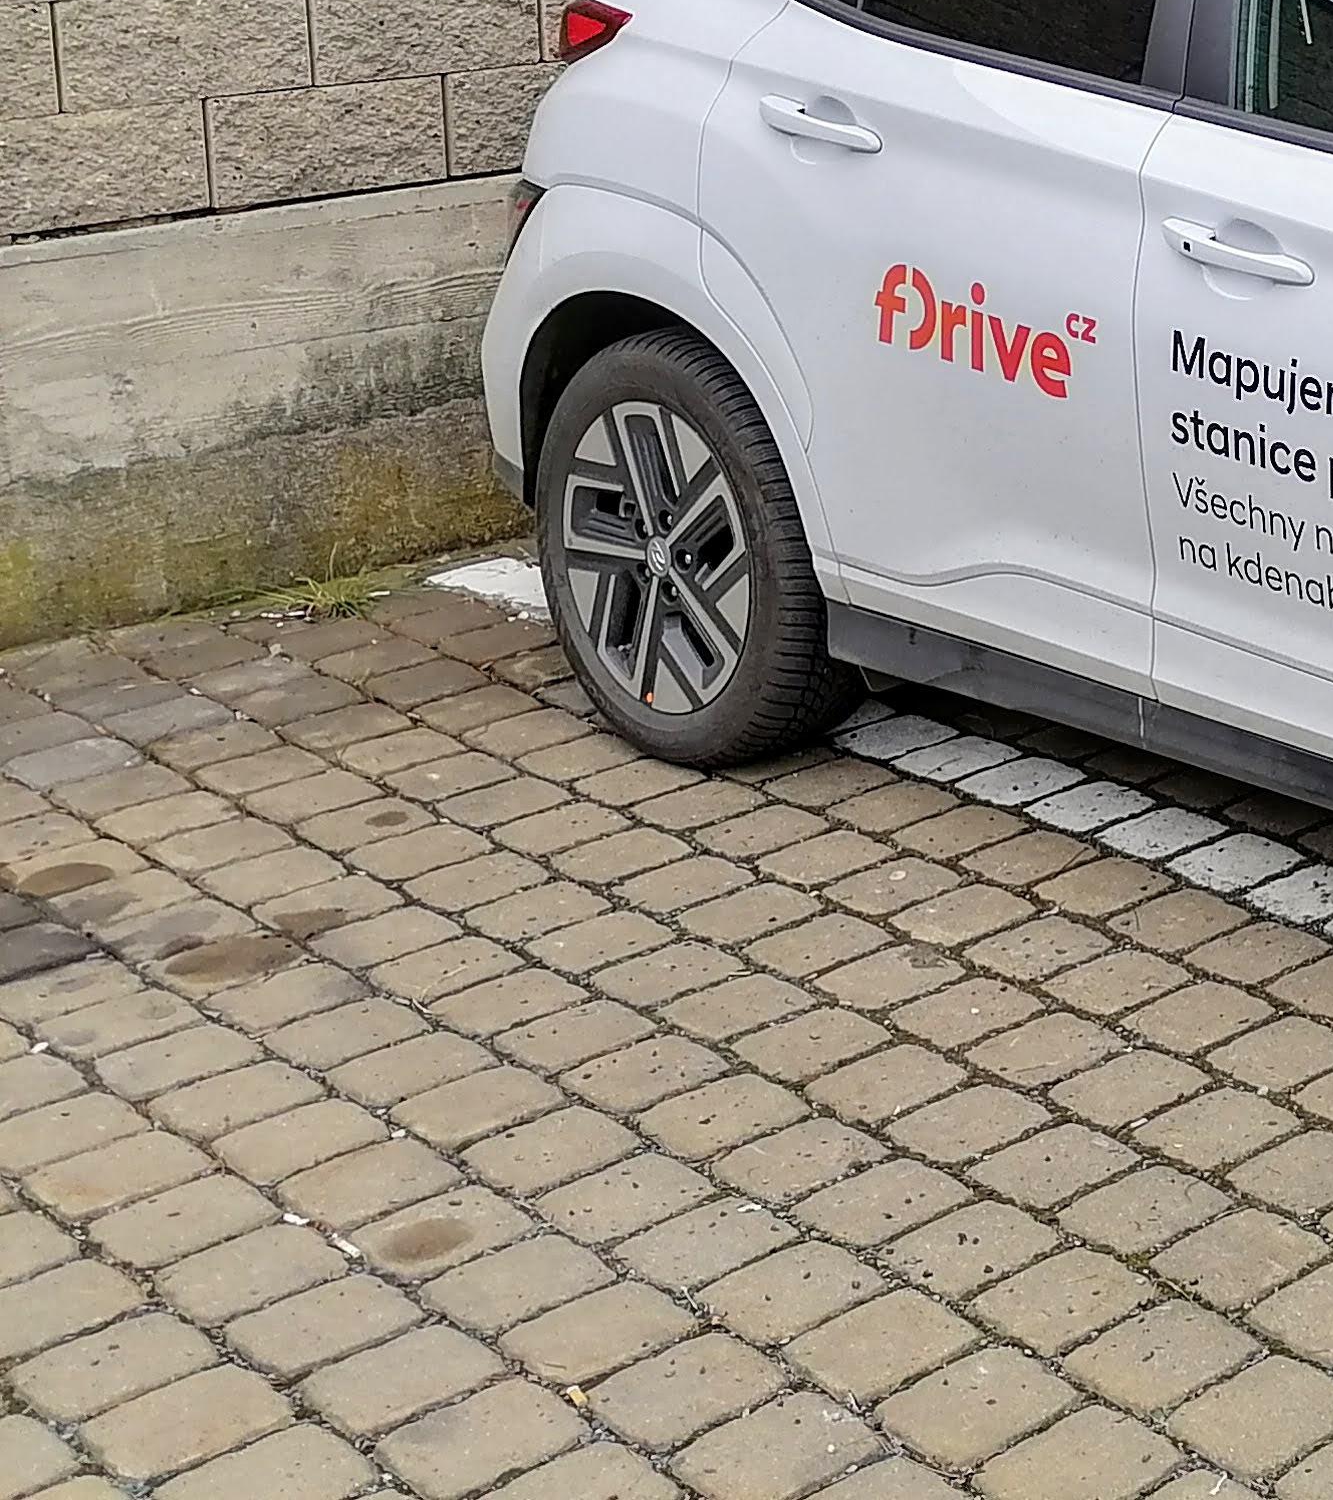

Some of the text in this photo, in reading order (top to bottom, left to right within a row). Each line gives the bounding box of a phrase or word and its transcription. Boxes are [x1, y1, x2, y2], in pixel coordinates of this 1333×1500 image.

[874, 263, 1072, 399] fDrive
[1171, 408, 1317, 482] stanice
[1172, 472, 1306, 552] Všechny
[1178, 532, 1218, 570] na
